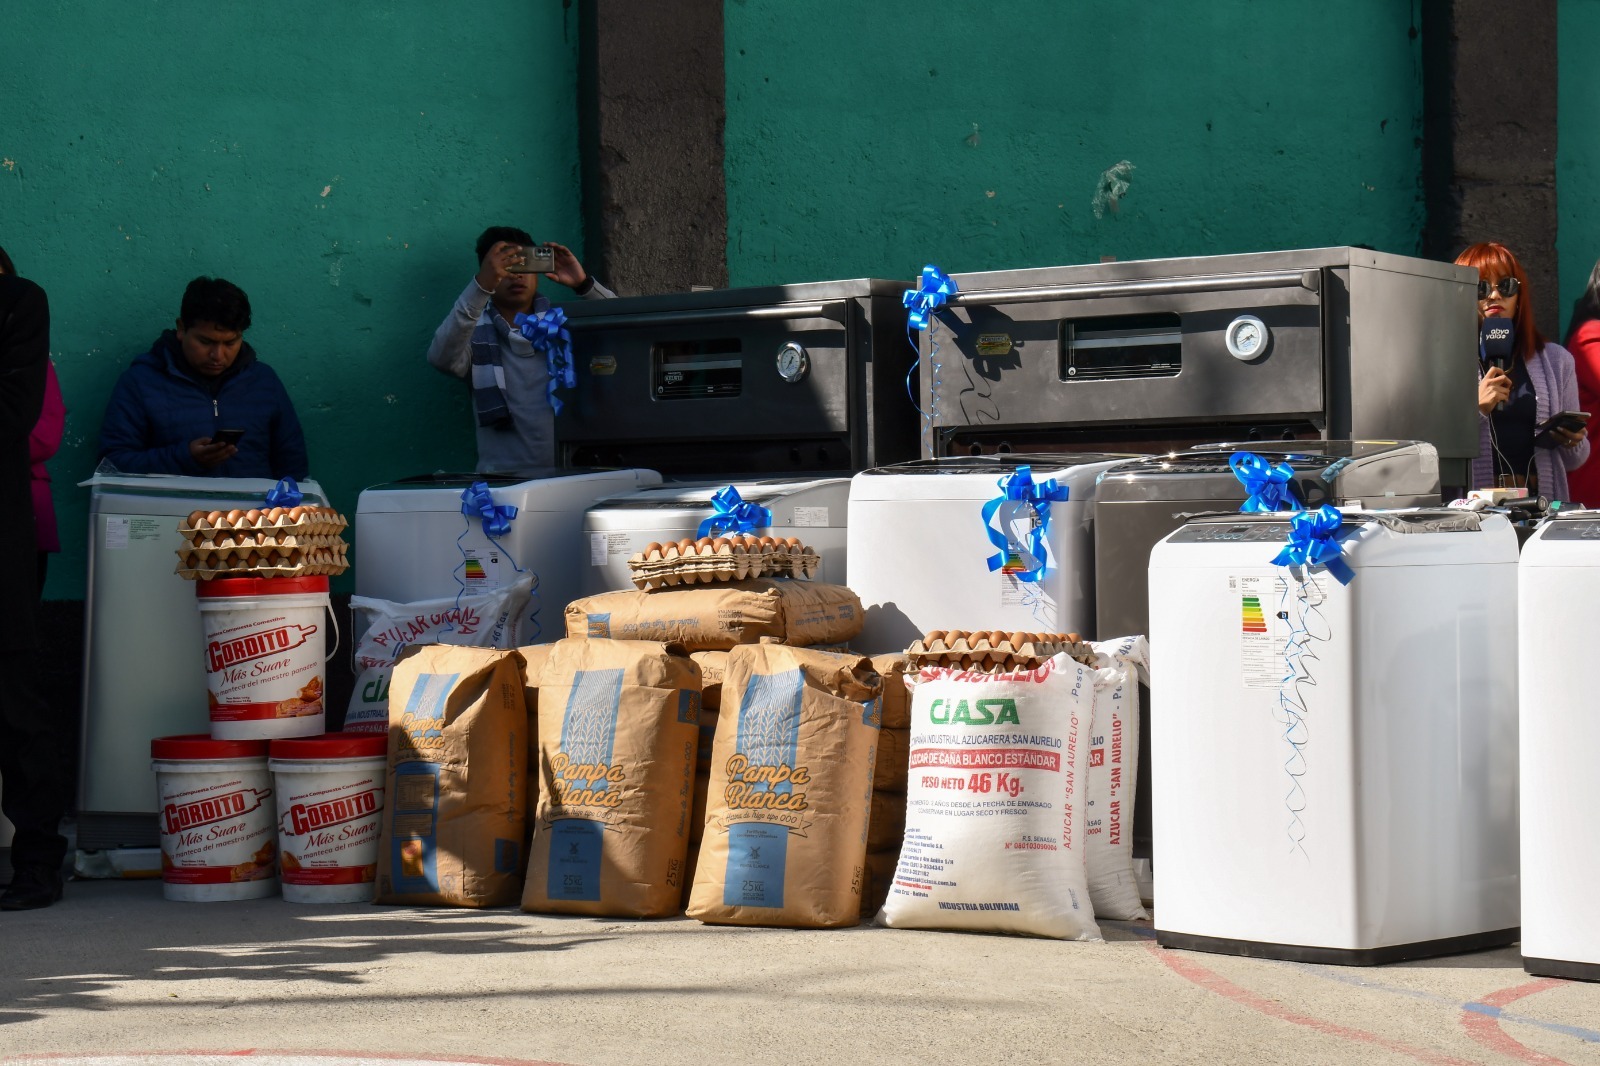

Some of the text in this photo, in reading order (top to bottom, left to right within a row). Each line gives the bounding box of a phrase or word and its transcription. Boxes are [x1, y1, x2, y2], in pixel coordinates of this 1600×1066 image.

[223, 623, 253, 635] Compuesta
[373, 615, 431, 647] AZUCAR
[492, 630, 501, 642] 46
[208, 628, 290, 673] GORDITO
[219, 683, 246, 696] manteca
[247, 679, 259, 688] del
[260, 672, 290, 684] maestro
[291, 661, 318, 677] panadero
[220, 658, 291, 687] Más Suave
[400, 711, 444, 738] Pampa
[399, 730, 446, 750] Blanca
[927, 734, 1062, 749] INDUSTRIAL AZUCARERA SAN AURELIO
[551, 751, 626, 788] Pampa
[725, 752, 811, 791] Pampa
[962, 753, 1003, 766] BLANCO
[1063, 803, 1074, 850] AZUCAR
[1071, 667, 1084, 697] Peso
[180, 787, 210, 798] Compuesta
[309, 786, 342, 797] Compuesta
[341, 778, 373, 789] Comestible
[550, 778, 623, 808] Blanca
[724, 782, 810, 812] Blanca
[921, 772, 1025, 798] PESO NETO 46 Kg.
[164, 792, 246, 835] GORDITO
[290, 791, 376, 836] GORDITO
[751, 809, 766, 821] Trigo
[767, 812, 778, 822] tipo
[934, 800, 950, 808] AÑOS
[950, 801, 972, 809] DESDE
[972, 801, 981, 809] LA
[982, 800, 1006, 808] FECHA
[1006, 800, 1016, 808] DE
[1017, 800, 1053, 809] ENVASADO
[953, 809, 975, 817] LUGAR
[1000, 808, 1028, 816] FRESCO
[176, 822, 246, 850] Más Suave
[304, 821, 377, 851] Más Suave
[1110, 800, 1121, 846] AZUCAR
[175, 847, 202, 858] manteca
[203, 843, 214, 852] del
[215, 835, 245, 849] maestro
[303, 847, 333, 859] manteca
[334, 843, 346, 852] del
[347, 835, 376, 849] maestro
[1033, 835, 1057, 844] SENASAG
[938, 901, 1020, 912] INDUSTRIA BOLIVIANA
